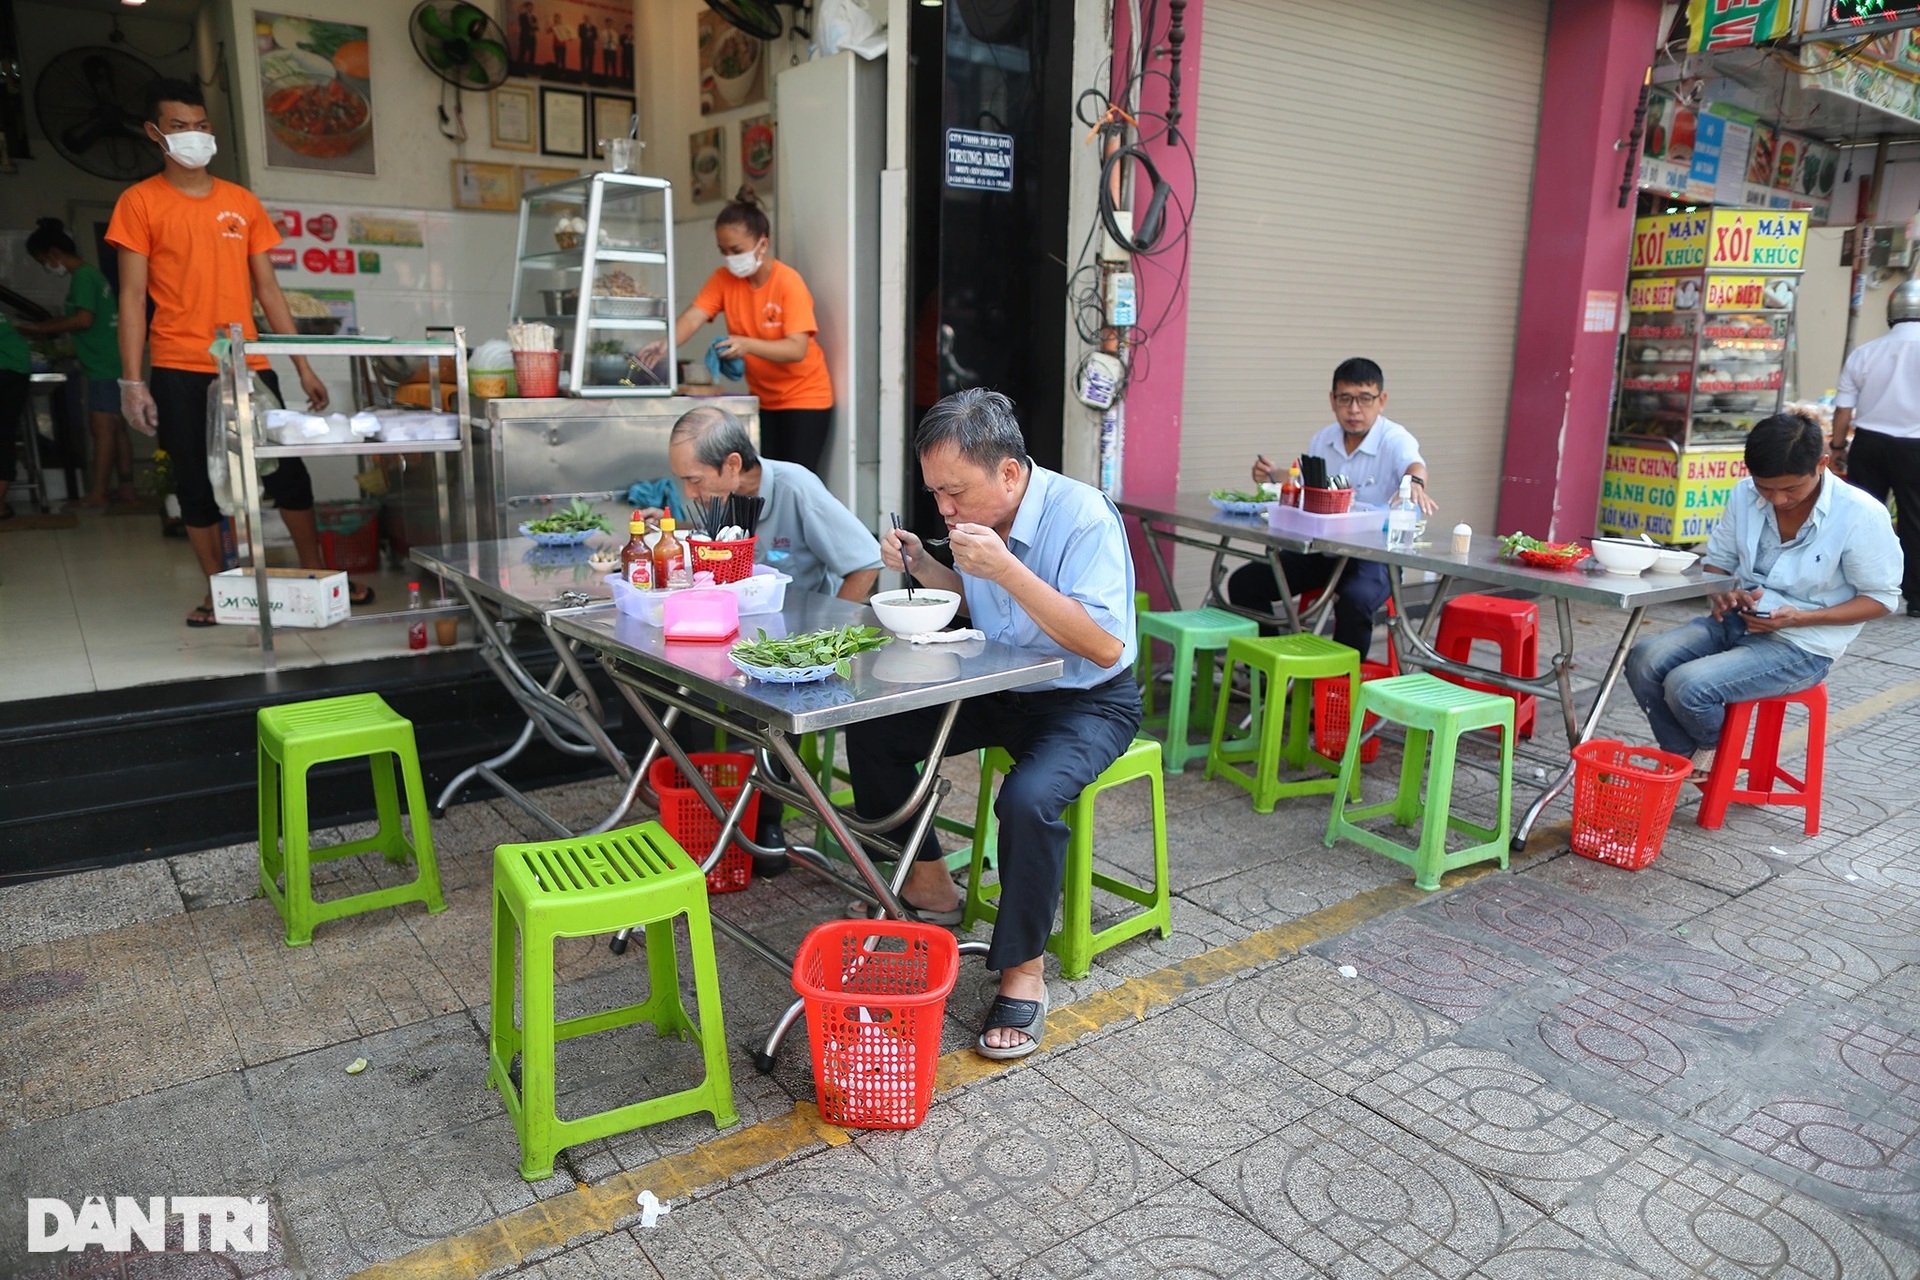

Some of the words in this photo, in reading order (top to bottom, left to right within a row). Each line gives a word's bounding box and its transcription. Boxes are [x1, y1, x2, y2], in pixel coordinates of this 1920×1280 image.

[948, 148, 982, 165] TRUNG
[1668, 217, 1706, 240] MẶN
[1713, 216, 1753, 262] XÔI
[1757, 216, 1802, 239] MẶN
[1634, 222, 1665, 266] XÔI
[1664, 244, 1704, 266] KHÚC
[1753, 244, 1799, 264] KHÚC
[1709, 279, 1734, 309] ĐẶC
[1736, 280, 1763, 310] BIỆT
[1774, 318, 1787, 336] 15
[1606, 450, 1636, 474] BÁNH
[1640, 456, 1678, 479] CHƯNG
[1688, 456, 1726, 479] BÁNH
[1603, 477, 1645, 502] BÁNH
[1648, 484, 1675, 507] GIÒ
[1602, 503, 1616, 525] XÔI
[1619, 507, 1639, 532] MẶN
[1645, 512, 1672, 535] KHÚC
[1681, 513, 1702, 536] XÔI
